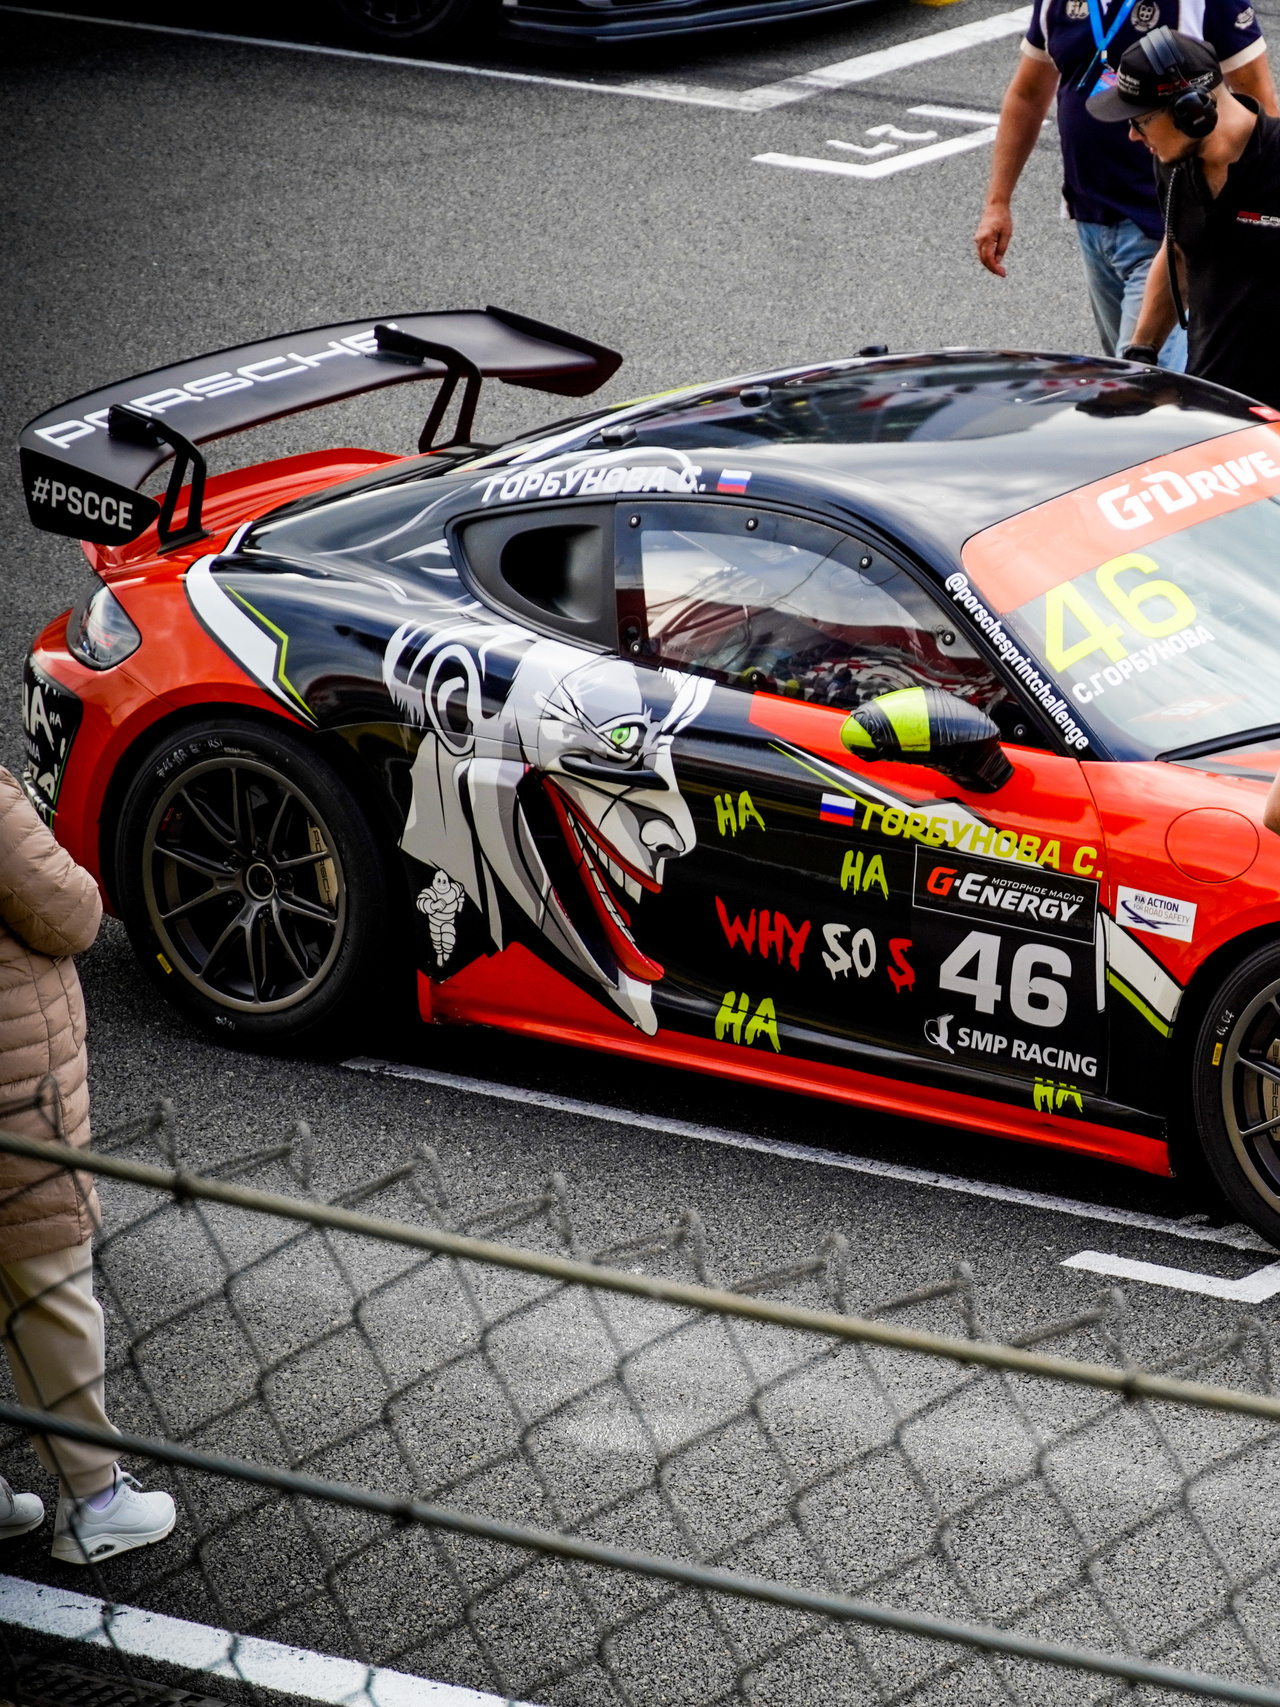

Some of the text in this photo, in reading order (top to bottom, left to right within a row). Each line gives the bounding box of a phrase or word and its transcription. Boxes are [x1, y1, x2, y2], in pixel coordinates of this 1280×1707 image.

[31, 475, 134, 531] #PSCCE
[481, 465, 668, 503] ГОРБУНОВА
[1045, 553, 1197, 673] 46
[944, 572, 1090, 750] @porschesprintchallenge
[714, 790, 766, 837] HA
[861, 802, 1061, 870] ГОРБУНОВА
[840, 850, 890, 901] HA
[991, 877, 1084, 903] МОТОРНОЕ МАСЛО
[1133, 903, 1190, 924] FOR ROAD SAFETY
[1134, 894, 1179, 913] FIA ACTION
[715, 895, 916, 992] WHY SO S
[938, 930, 1073, 1028] 46
[714, 990, 782, 1054] HA
[957, 1027, 1098, 1078] SMP RACING
